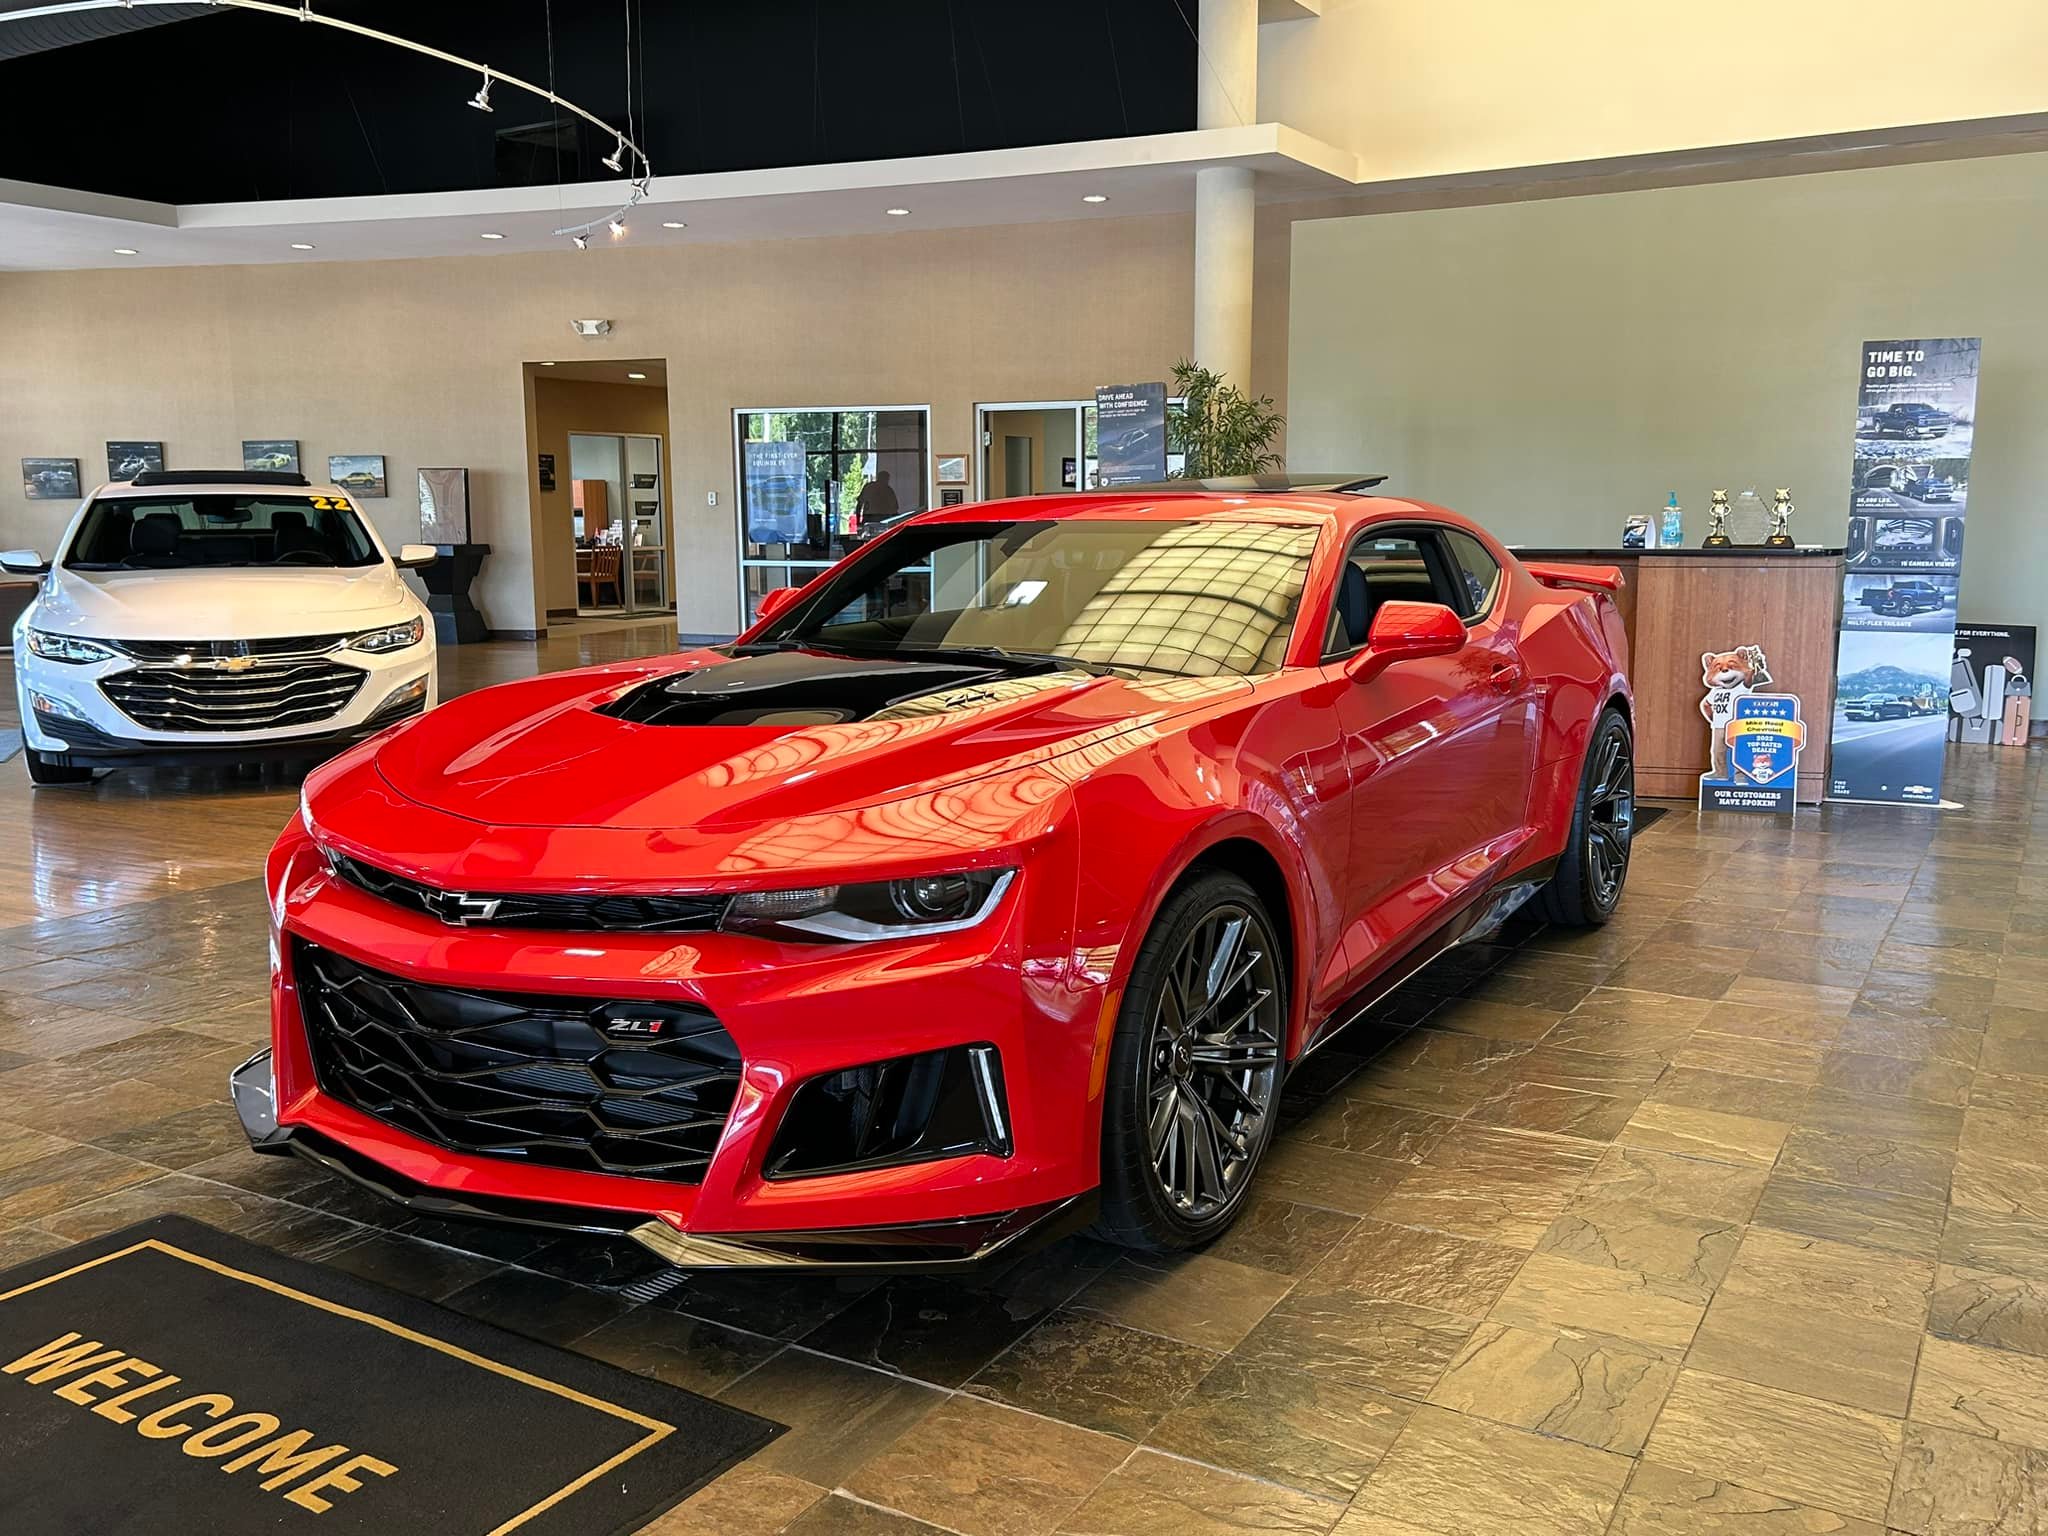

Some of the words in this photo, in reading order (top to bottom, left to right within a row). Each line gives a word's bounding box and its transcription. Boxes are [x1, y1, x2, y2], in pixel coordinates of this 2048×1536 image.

[1868, 350, 1902, 363] TIME
[1906, 350, 1925, 362] TO
[1867, 366, 1886, 378] GO
[1889, 365, 1917, 377] BIG.
[1098, 394, 1114, 402] DRIVE
[1115, 392, 1134, 400] AHEAD
[308, 496, 352, 511] 22
[1713, 692, 1731, 703] CAR
[1714, 790, 1731, 798] OUR
[1732, 790, 1781, 800] CUSTOMERS
[1718, 798, 1741, 806] HAVE
[1741, 799, 1776, 807] SPOKEN!
[607, 1018, 664, 1033] ZL1
[1, 1331, 400, 1514] WELCOME
